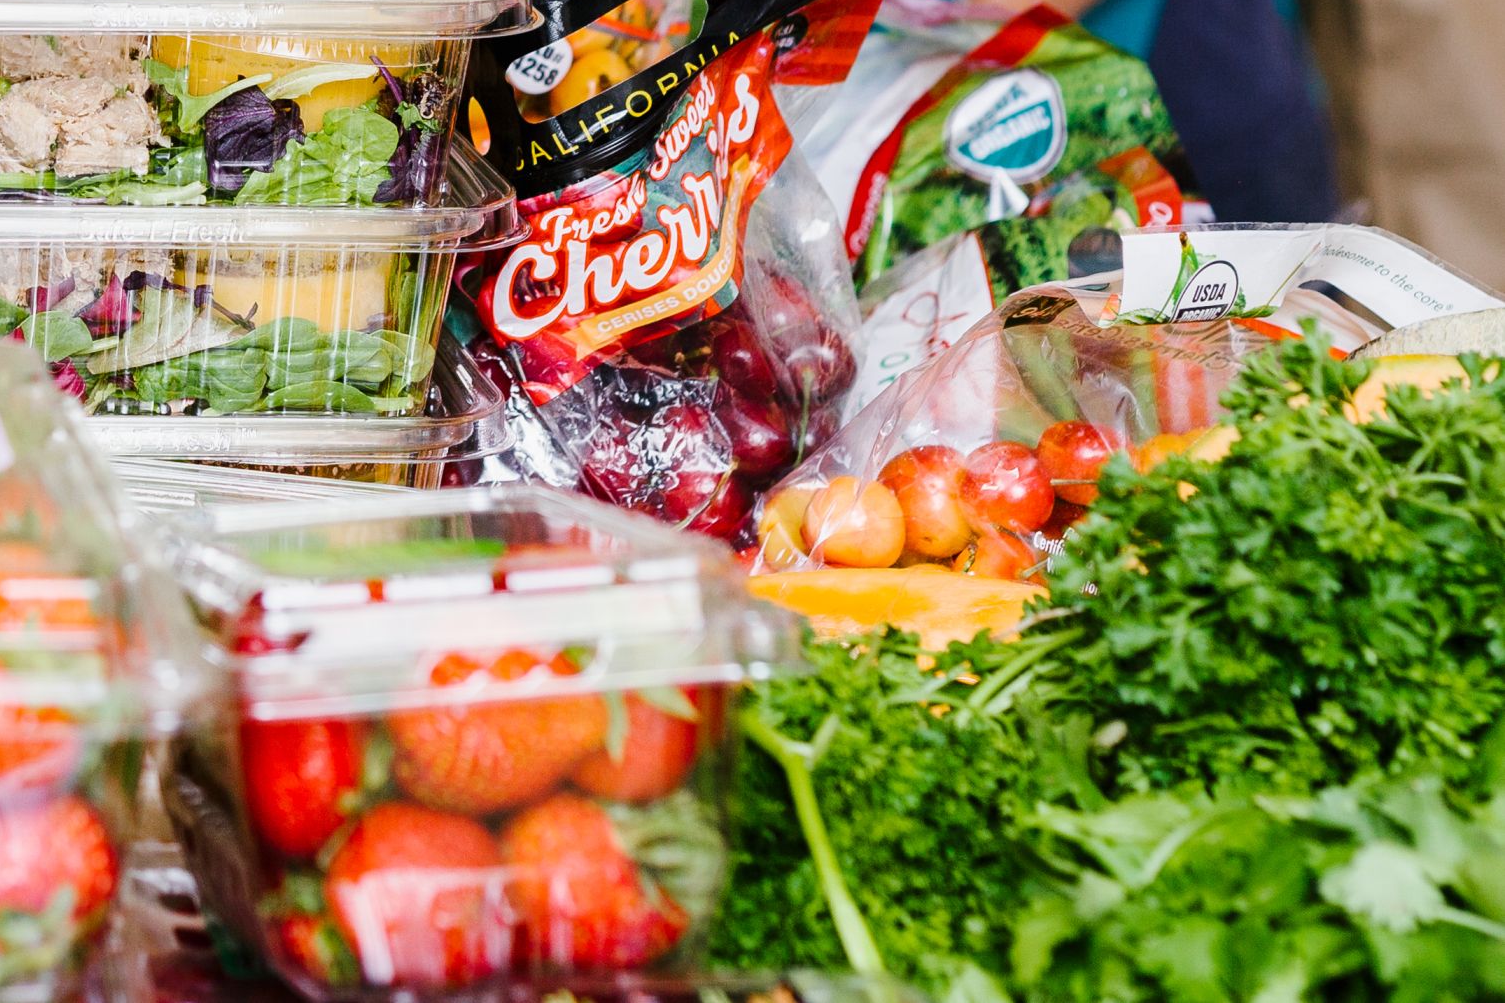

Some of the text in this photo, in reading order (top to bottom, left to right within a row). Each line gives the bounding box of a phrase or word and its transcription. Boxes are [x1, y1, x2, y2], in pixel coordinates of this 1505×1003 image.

[540, 171, 646, 252] Fresh
[650, 70, 716, 180] Sweet
[1192, 283, 1227, 303] USDA
[1374, 262, 1391, 278] to
[1390, 273, 1415, 293] the
[596, 294, 681, 334] CERISES
